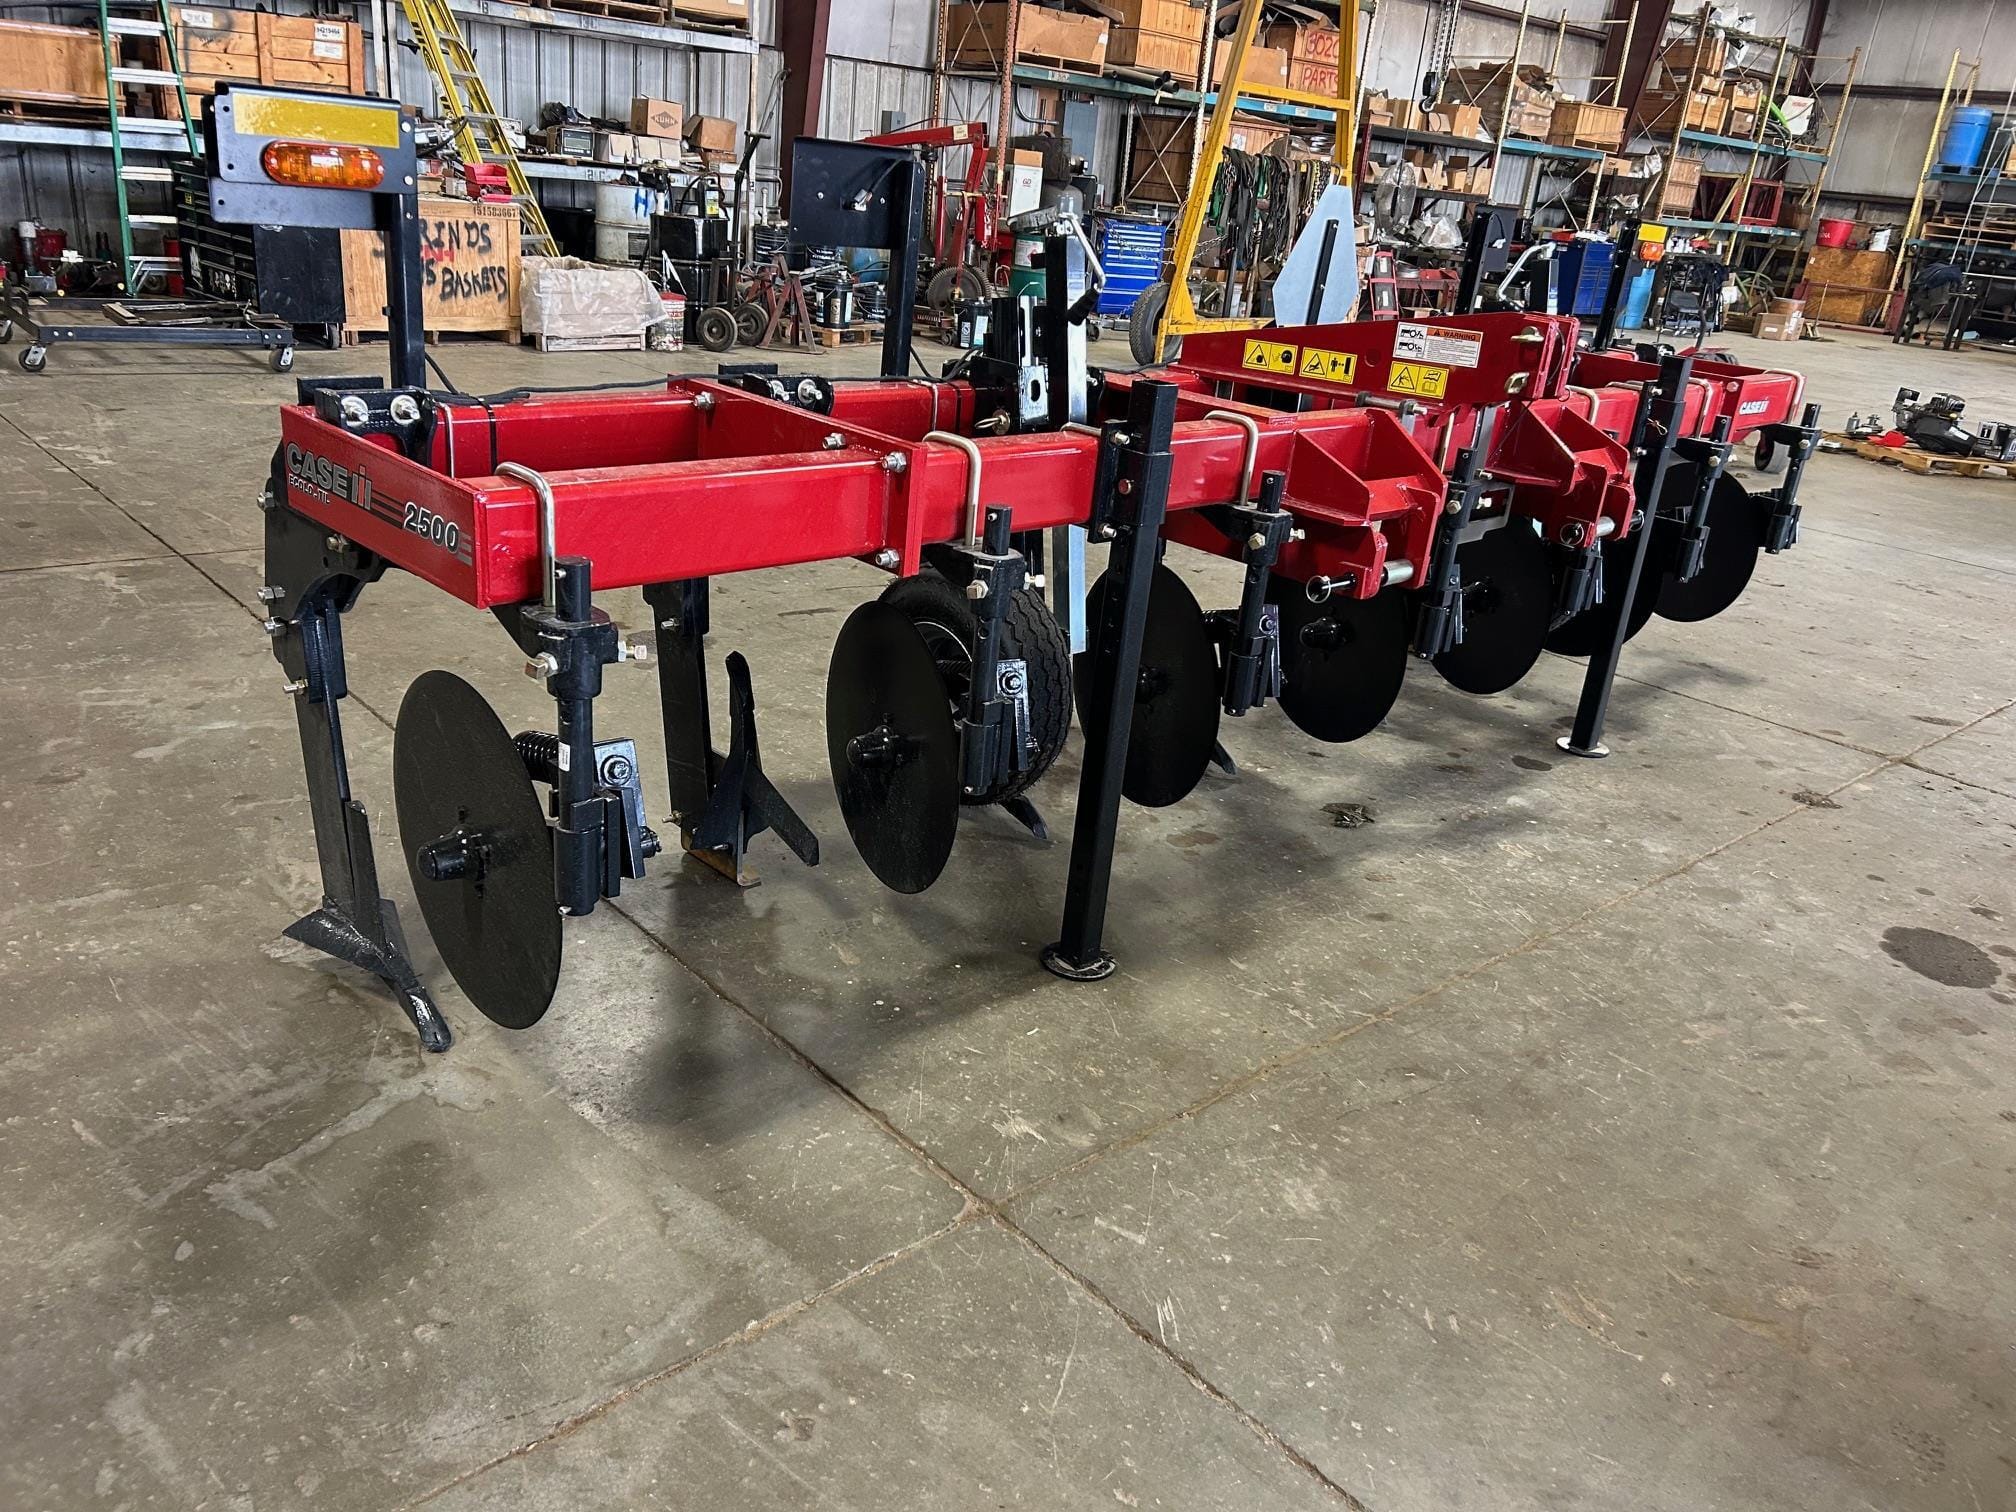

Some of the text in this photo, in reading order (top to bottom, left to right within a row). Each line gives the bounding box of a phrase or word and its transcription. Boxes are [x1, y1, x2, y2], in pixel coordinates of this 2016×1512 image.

[653, 114, 676, 126] KUHN
[439, 265, 508, 303] BASKETS
[1443, 330, 1476, 341] WARNING
[286, 442, 348, 499] CASE
[403, 501, 460, 555] 2500
